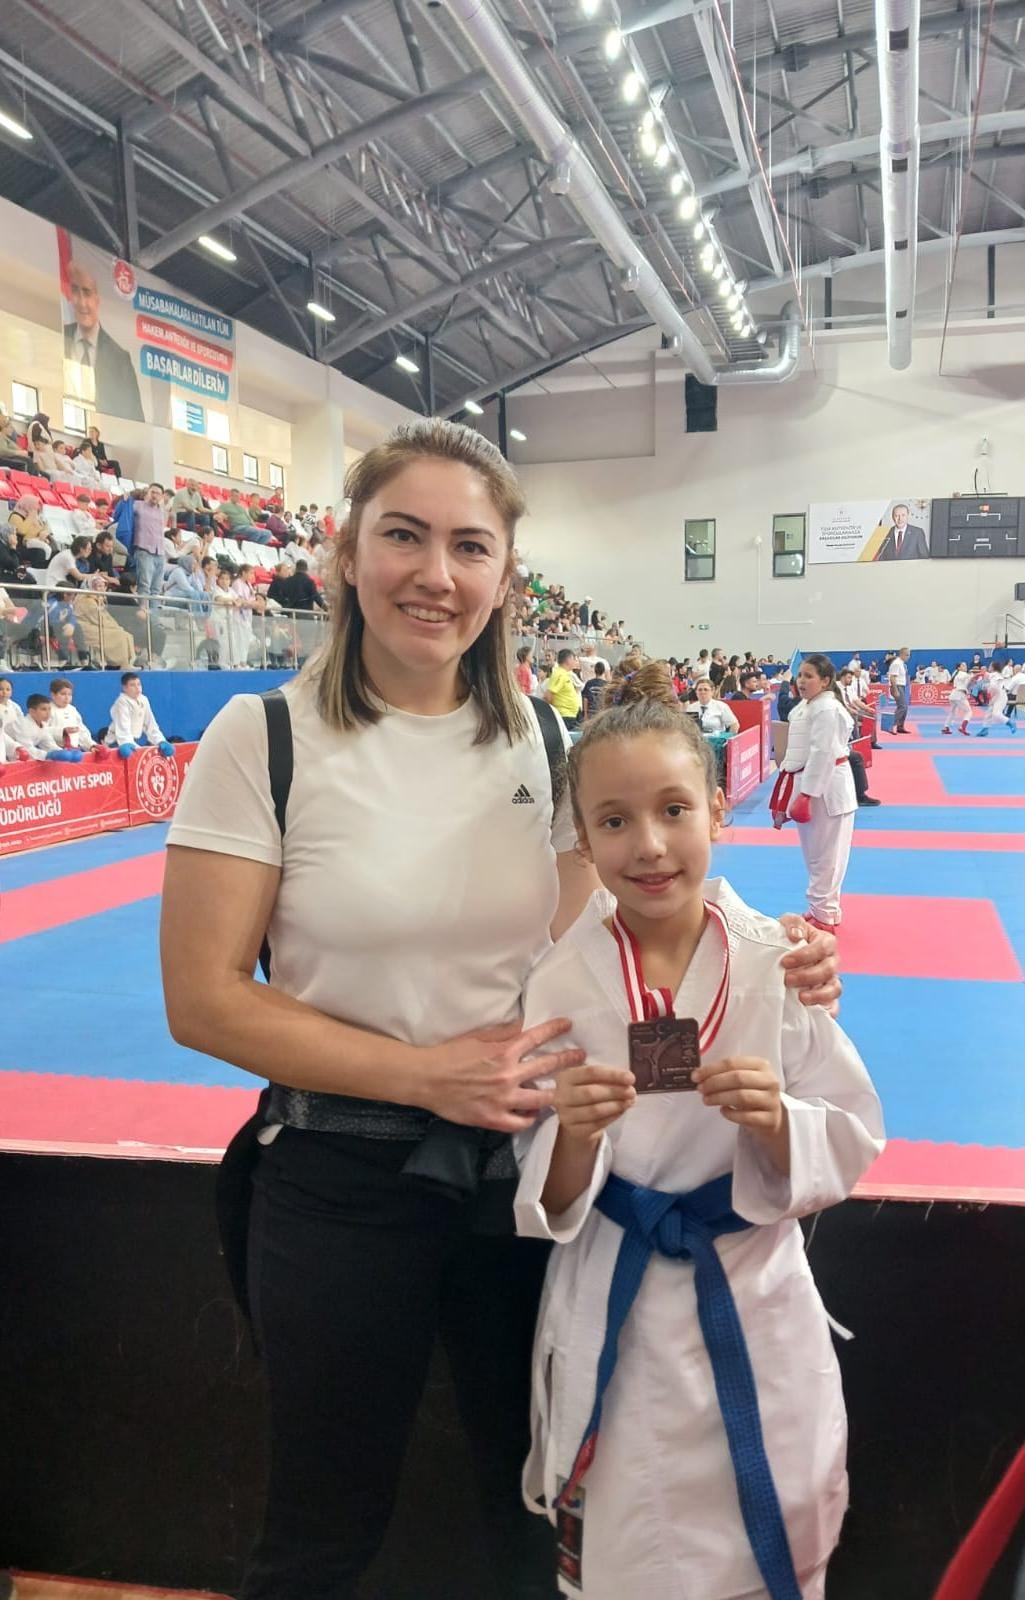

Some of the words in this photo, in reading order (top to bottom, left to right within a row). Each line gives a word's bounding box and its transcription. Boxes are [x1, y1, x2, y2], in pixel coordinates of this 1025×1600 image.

[191, 311, 216, 331] KATILAN
[216, 319, 229, 336] TÜM
[146, 351, 192, 383] BAŞARILAR
[193, 367, 225, 394] DİLERİM
[27, 776, 73, 798] GENÇLİK
[73, 775, 87, 790] VE
[88, 772, 113, 788] SPOR
[0, 799, 62, 826] ÜDÜRLÜĞÜ
